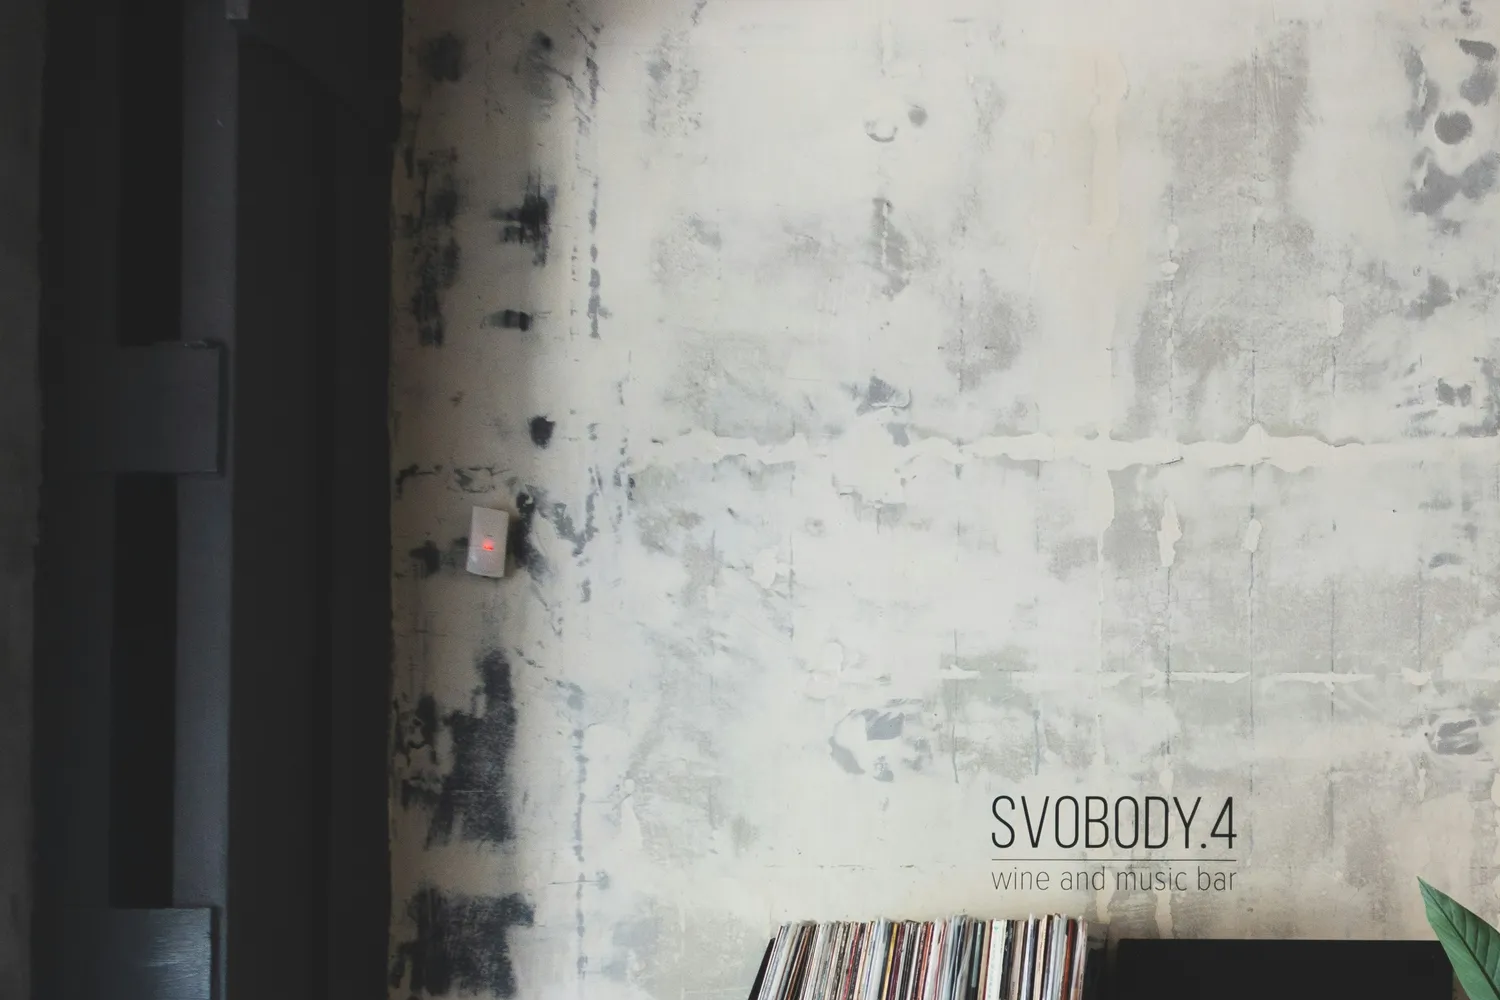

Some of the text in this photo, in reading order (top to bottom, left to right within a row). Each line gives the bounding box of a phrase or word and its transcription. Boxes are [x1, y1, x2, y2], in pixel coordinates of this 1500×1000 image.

[991, 795, 1237, 849] SVOBODY.4
[991, 866, 1238, 891] wine and music bar
